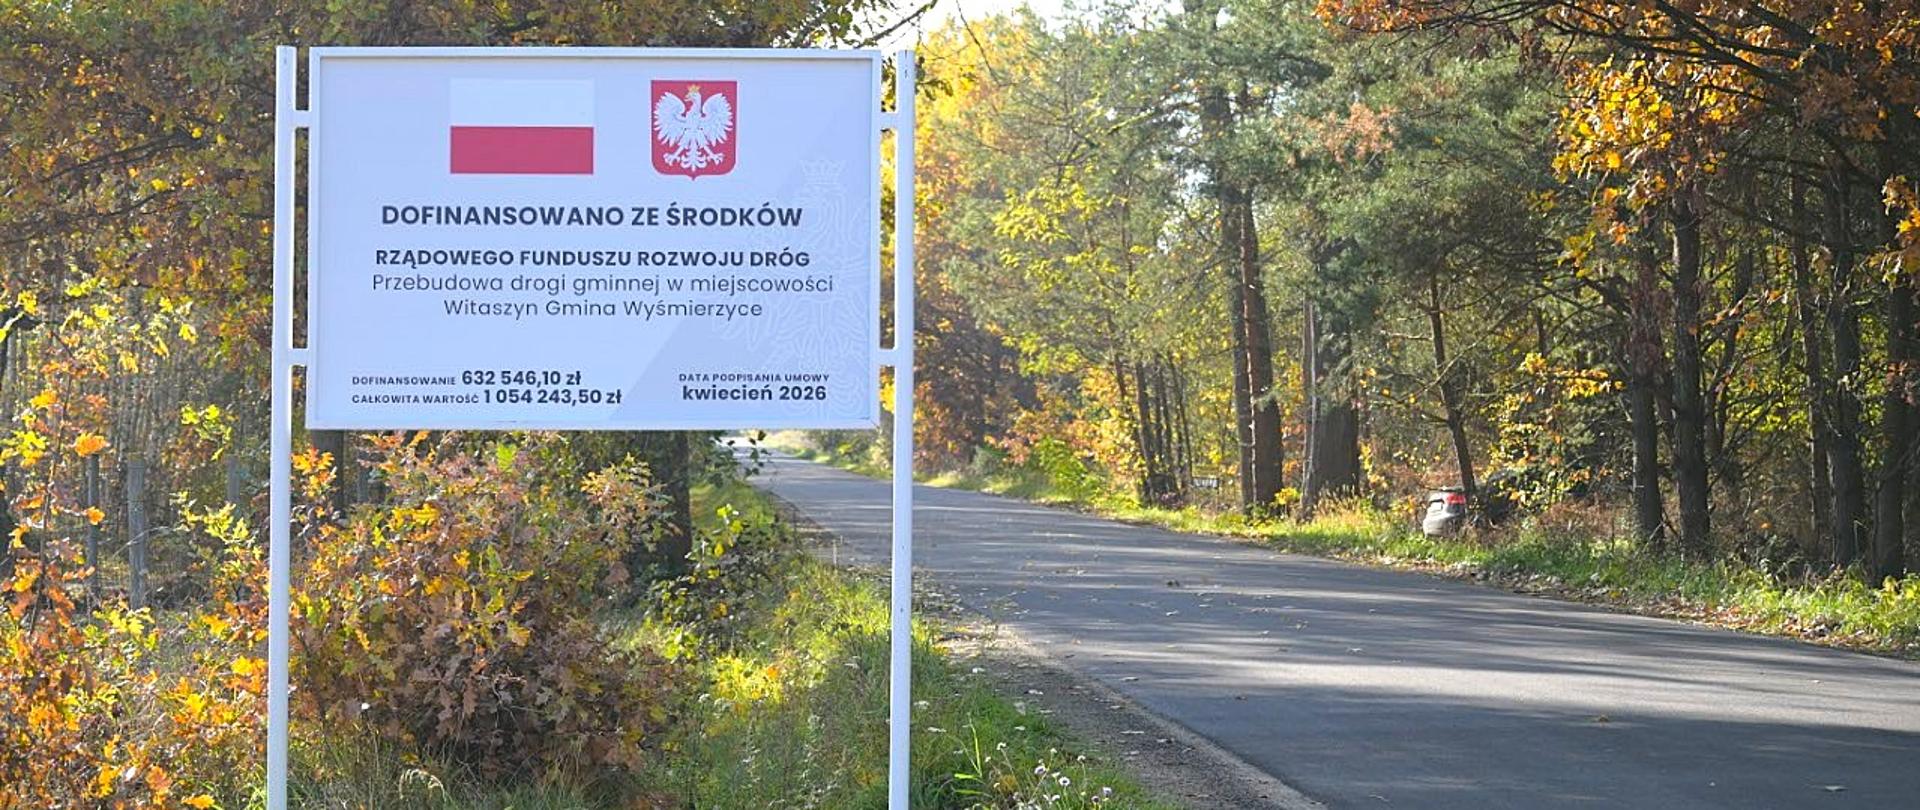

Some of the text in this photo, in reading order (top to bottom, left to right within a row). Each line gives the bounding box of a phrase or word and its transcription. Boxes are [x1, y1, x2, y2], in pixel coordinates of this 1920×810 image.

[382, 202, 802, 226] DOFINANSOWANO ZE ŚRODKÓW
[376, 247, 809, 269] RZĄDOWEGO FUNDUSZU ROZWOJU DRÓG
[373, 274, 832, 296] Przebudowa drogi gminnej w miejscowości
[444, 299, 762, 321] Witaszyn Gmina Wyśmierzyce
[352, 370, 581, 387] DOFINANSOWANIE 632 546,10 zł
[678, 373, 830, 383] DATA PODPISANIA UMOWY
[352, 388, 622, 406] CAŁKOWITA WARTOŚĆ 1 054 243,50 zł
[683, 384, 826, 400] kwiecień 2026
